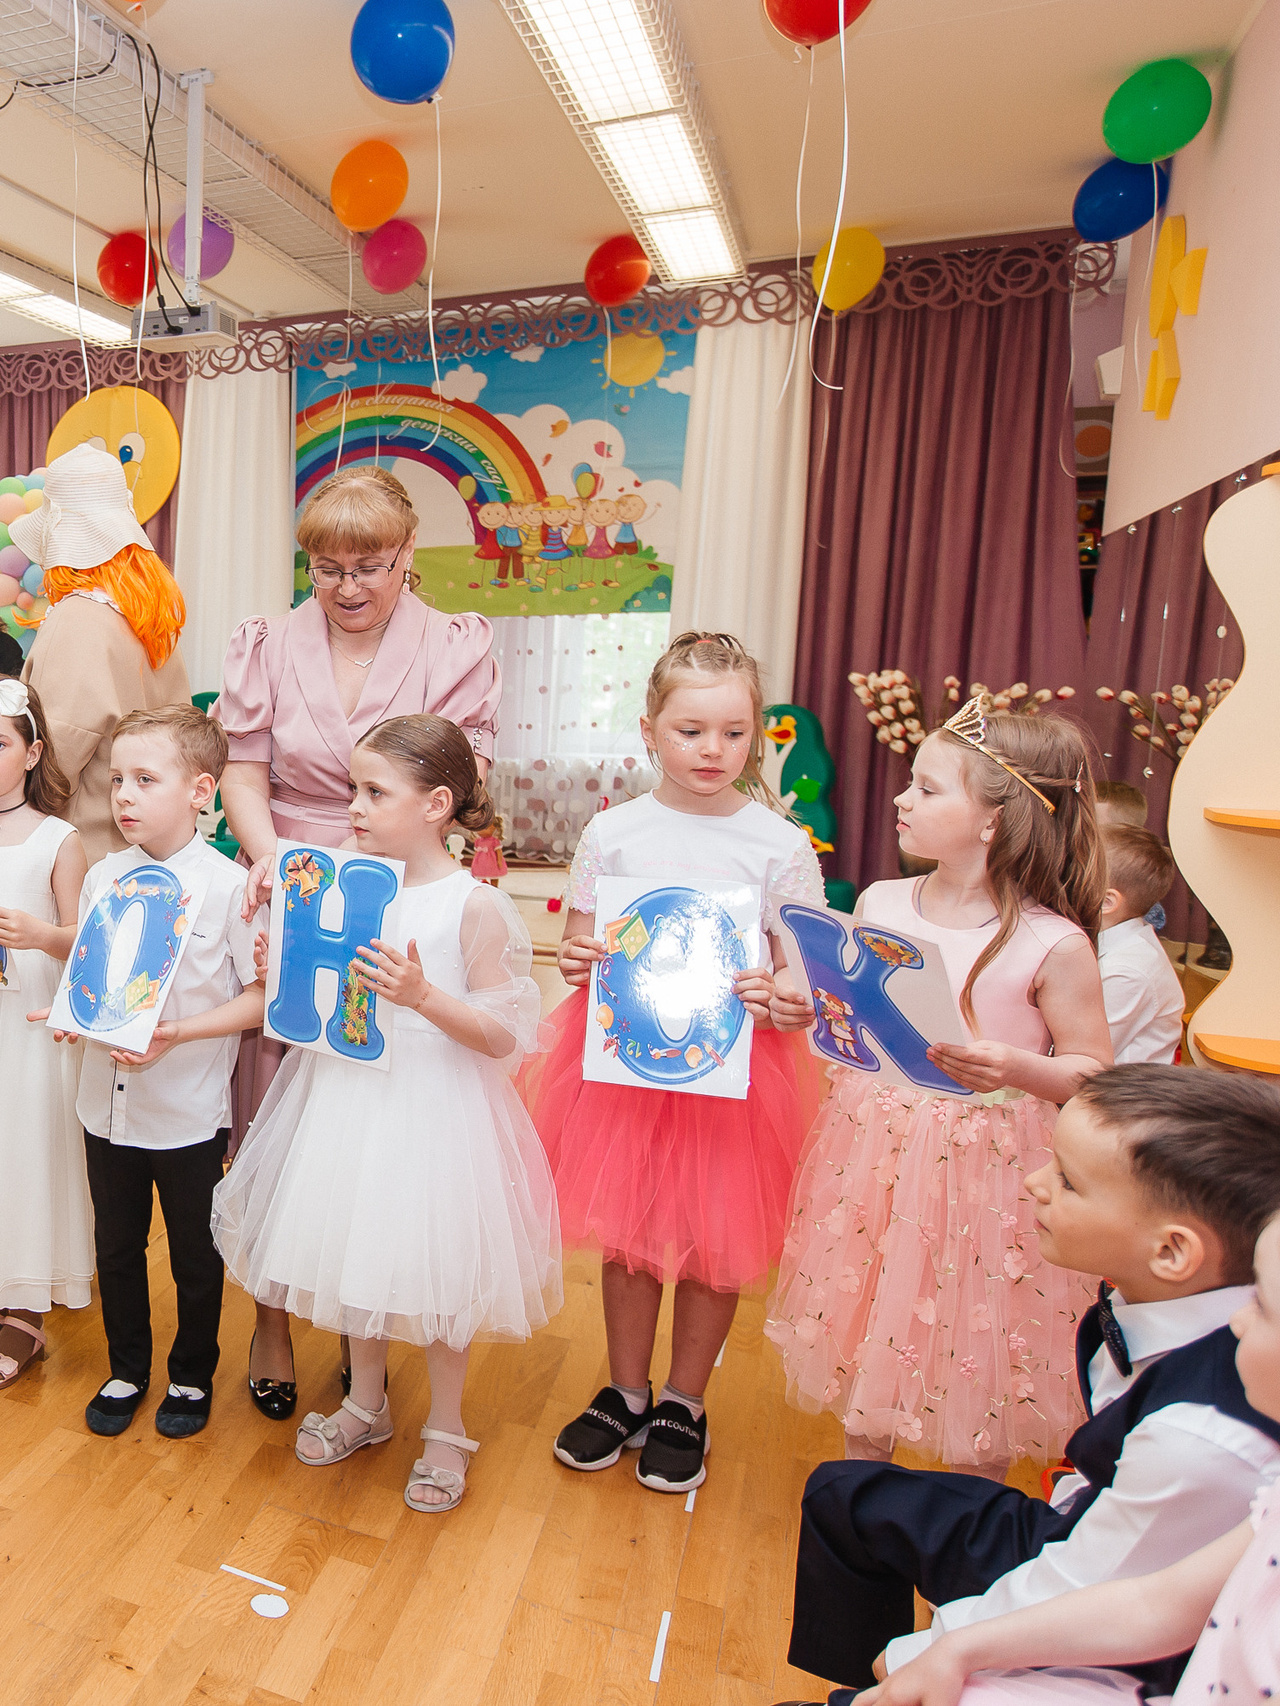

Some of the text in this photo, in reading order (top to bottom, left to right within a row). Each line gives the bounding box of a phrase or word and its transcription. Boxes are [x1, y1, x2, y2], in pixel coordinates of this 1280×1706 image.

[268, 848, 397, 1061] Н
[779, 903, 975, 1096] К
[597, 1411, 630, 1437] COUTURE
[667, 1420, 701, 1441] COUTURE
